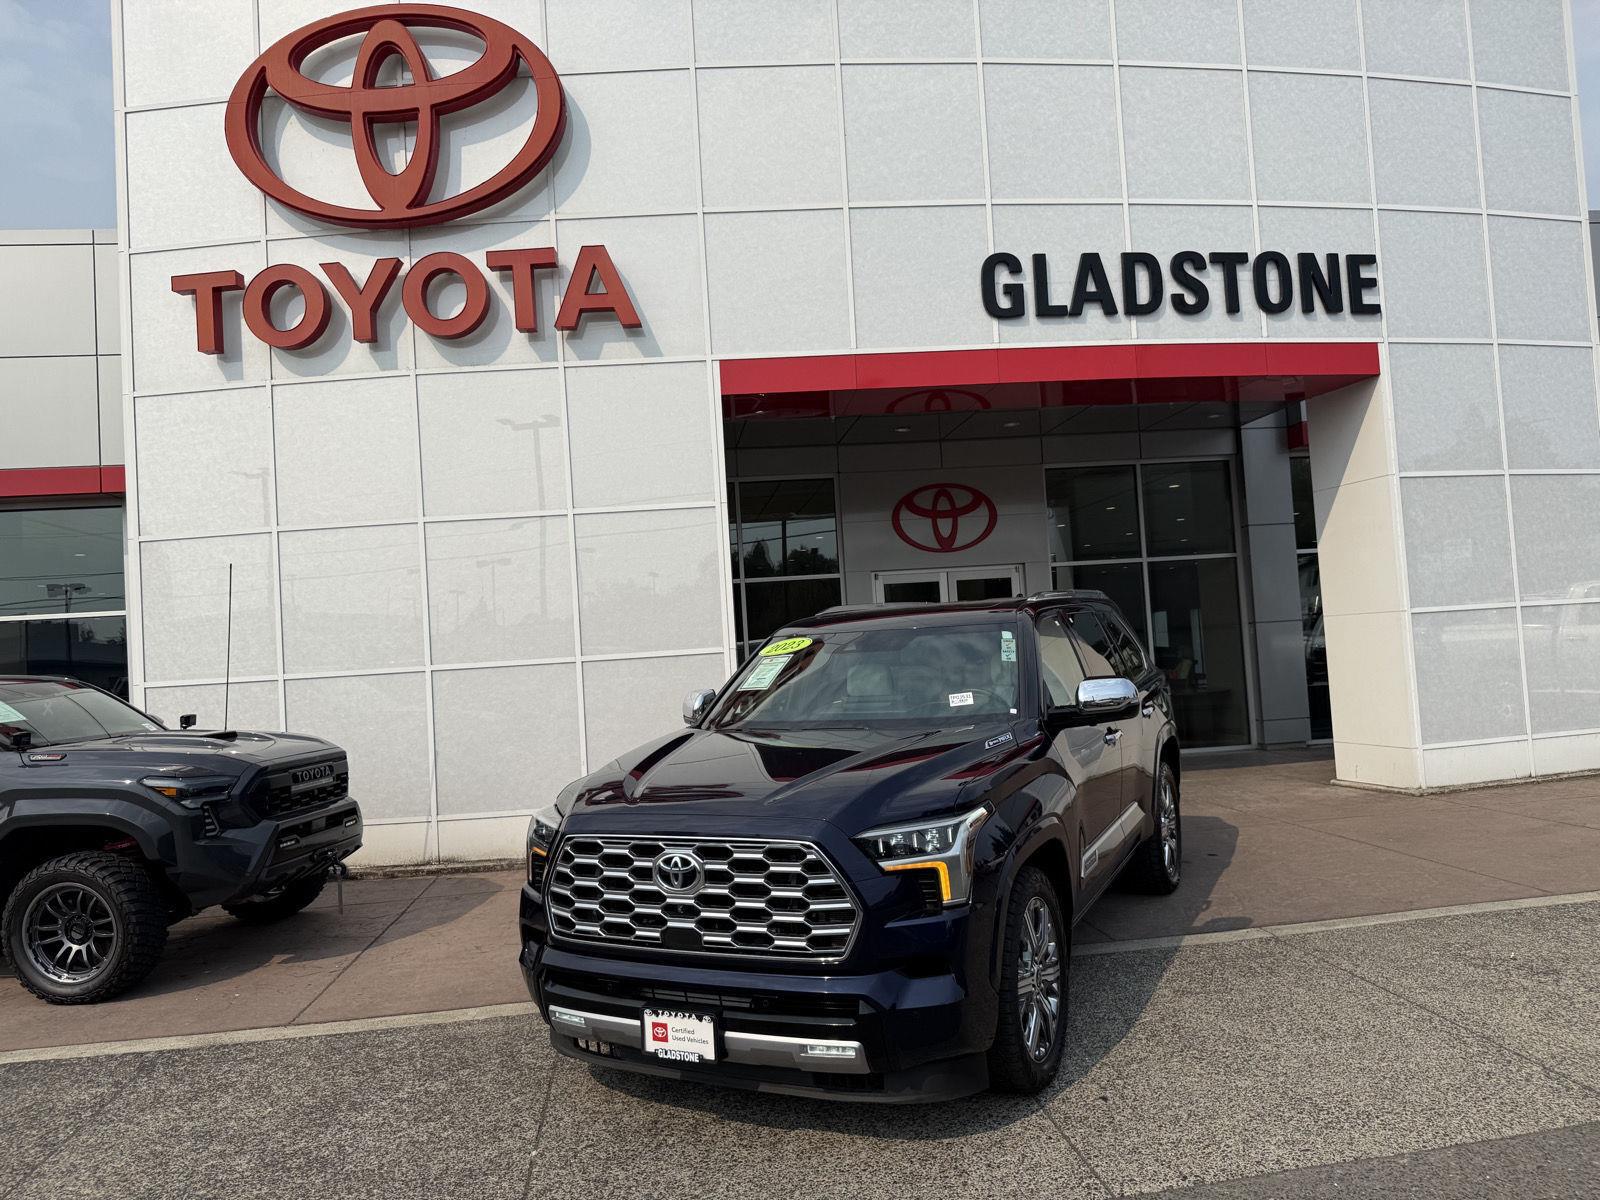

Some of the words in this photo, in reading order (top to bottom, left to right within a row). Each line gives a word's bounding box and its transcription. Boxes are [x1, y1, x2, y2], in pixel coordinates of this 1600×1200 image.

[981, 250, 1381, 318] GLADSTONE
[171, 244, 643, 355] TOYOTA
[765, 639, 806, 654] 2023
[296, 765, 331, 782] TOYOTA
[657, 1010, 697, 1020] TOYOTA
[671, 1026, 695, 1035] Certified
[686, 1036, 709, 1045] Vehicles
[657, 1048, 700, 1063] GLADSTONE
